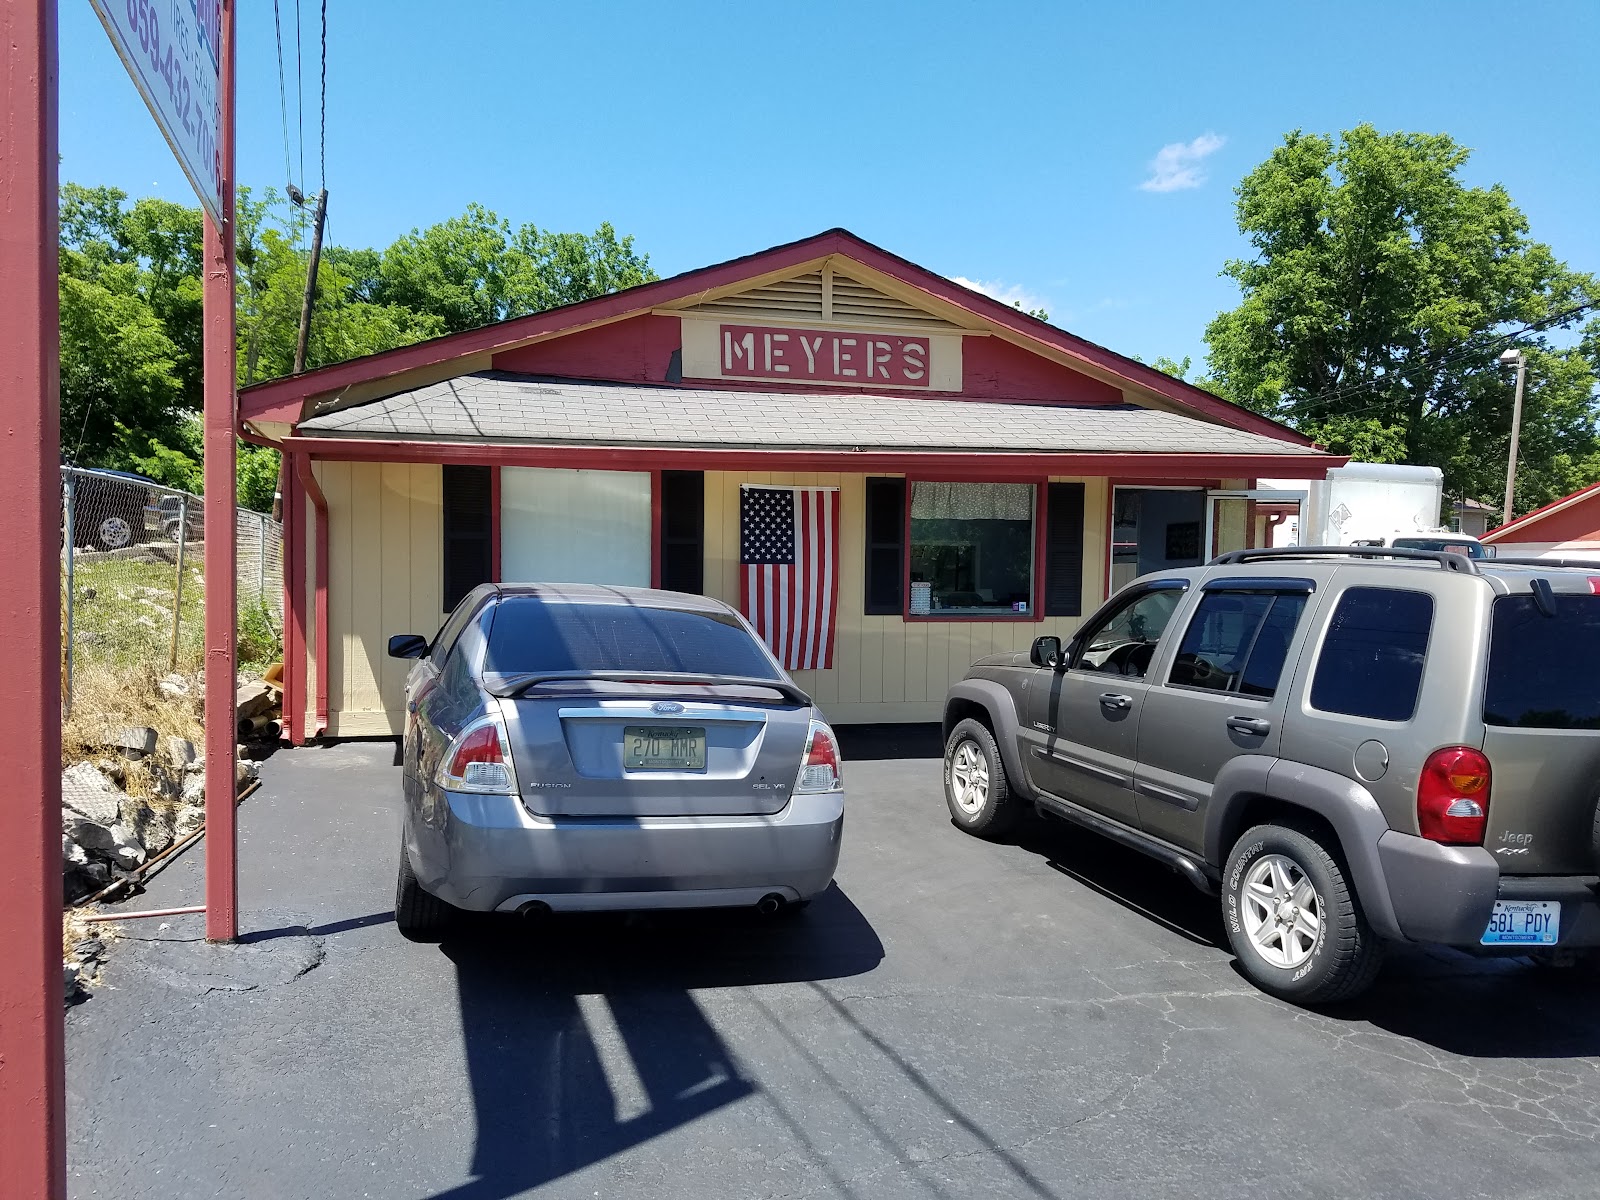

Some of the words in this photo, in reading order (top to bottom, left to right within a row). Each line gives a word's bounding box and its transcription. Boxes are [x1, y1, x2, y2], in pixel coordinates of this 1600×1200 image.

[724, 331, 926, 380] MEYER'S
[657, 703, 677, 712] Ford
[648, 731, 679, 739] Kentucky
[1033, 720, 1055, 733] LIBERTY
[634, 738, 660, 757] 270
[671, 738, 697, 757] MMR
[1499, 831, 1533, 845] Jeep
[1230, 841, 1264, 890] COUNTRY
[1228, 894, 1240, 933] WILD
[1504, 904, 1535, 913] Kentucky
[1314, 894, 1326, 956] RADIAL
[1490, 913, 1514, 932] 581
[1525, 913, 1551, 932] PDY
[1292, 960, 1313, 981] XRT
